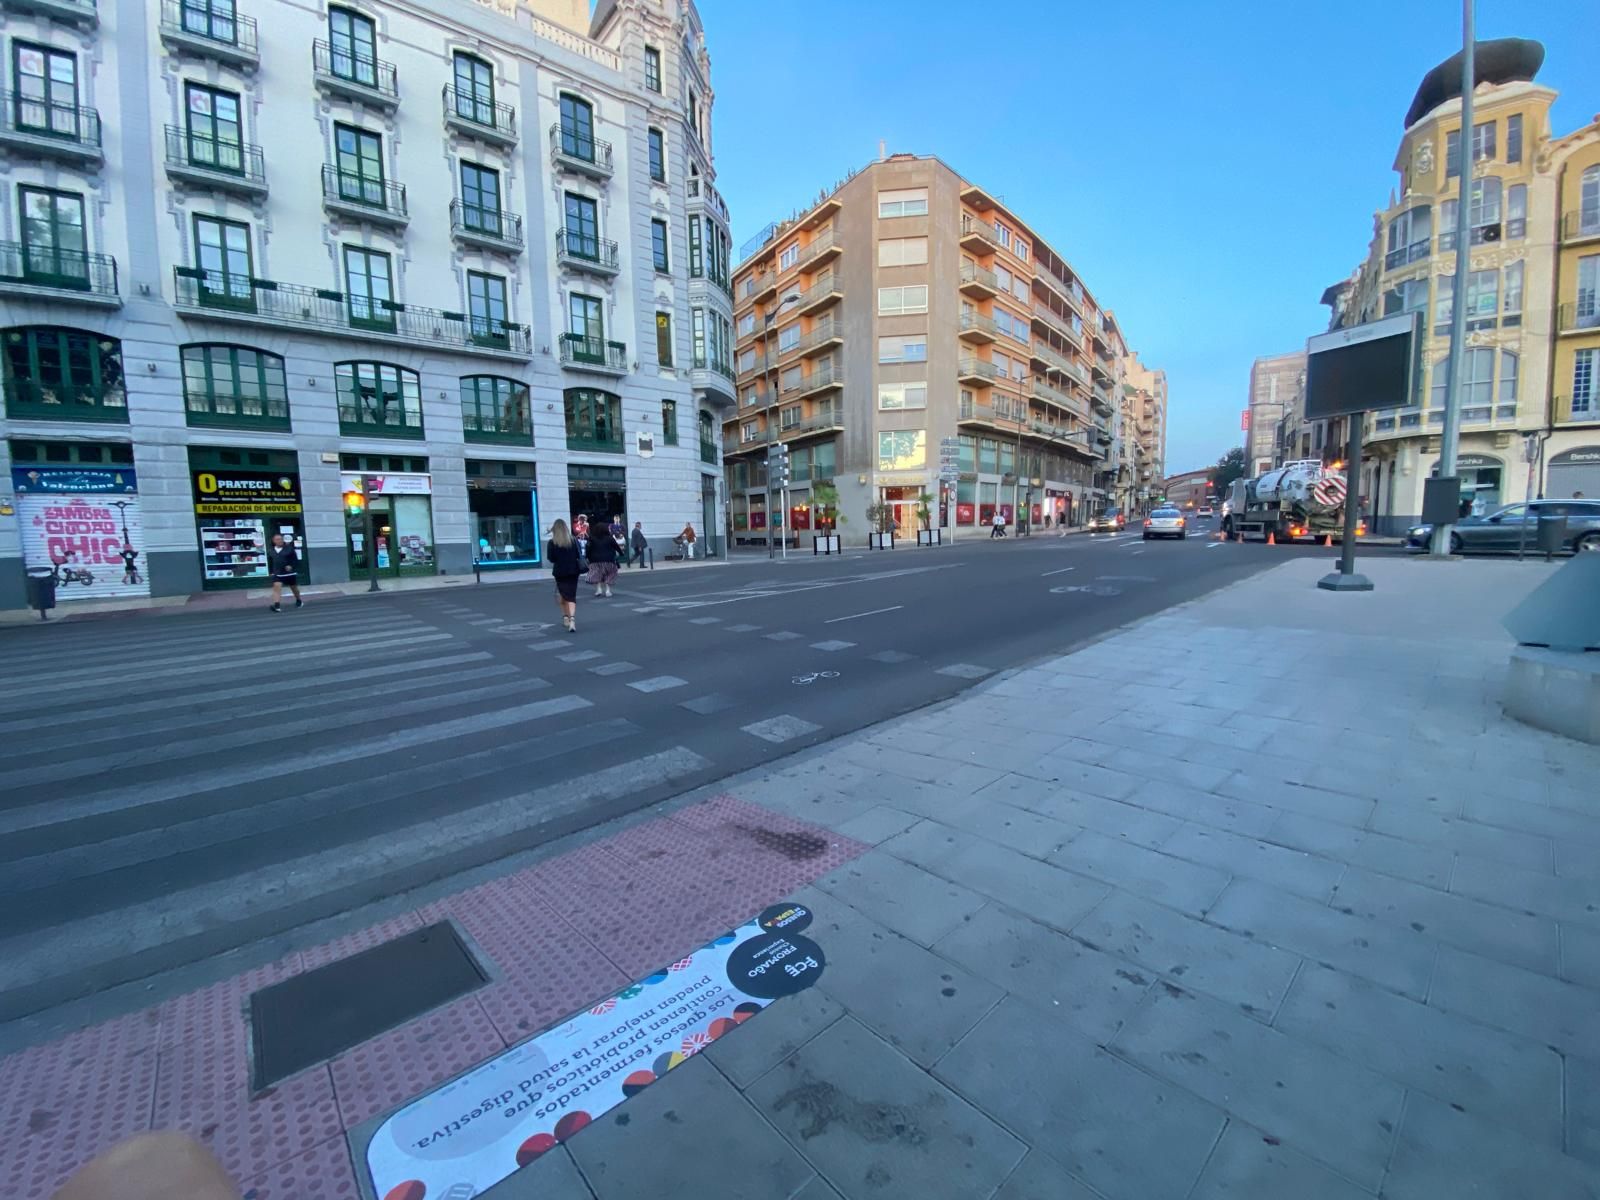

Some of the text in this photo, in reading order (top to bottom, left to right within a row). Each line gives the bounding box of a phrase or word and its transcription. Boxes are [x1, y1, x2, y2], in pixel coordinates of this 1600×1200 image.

[1456, 457, 1483, 465] ershka
[45, 521, 116, 535] CIUDAD
[657, 975, 712, 1010] pueden
[708, 994, 735, 1013] Los
[592, 1009, 656, 1050] mejorar
[653, 1011, 707, 1047] quesos
[503, 985, 722, 1119] contienen probióticos que
[572, 1047, 593, 1061] la
[518, 1058, 569, 1093] salud
[535, 1044, 653, 1120] fermentados
[411, 1090, 514, 1149] digestiva.
